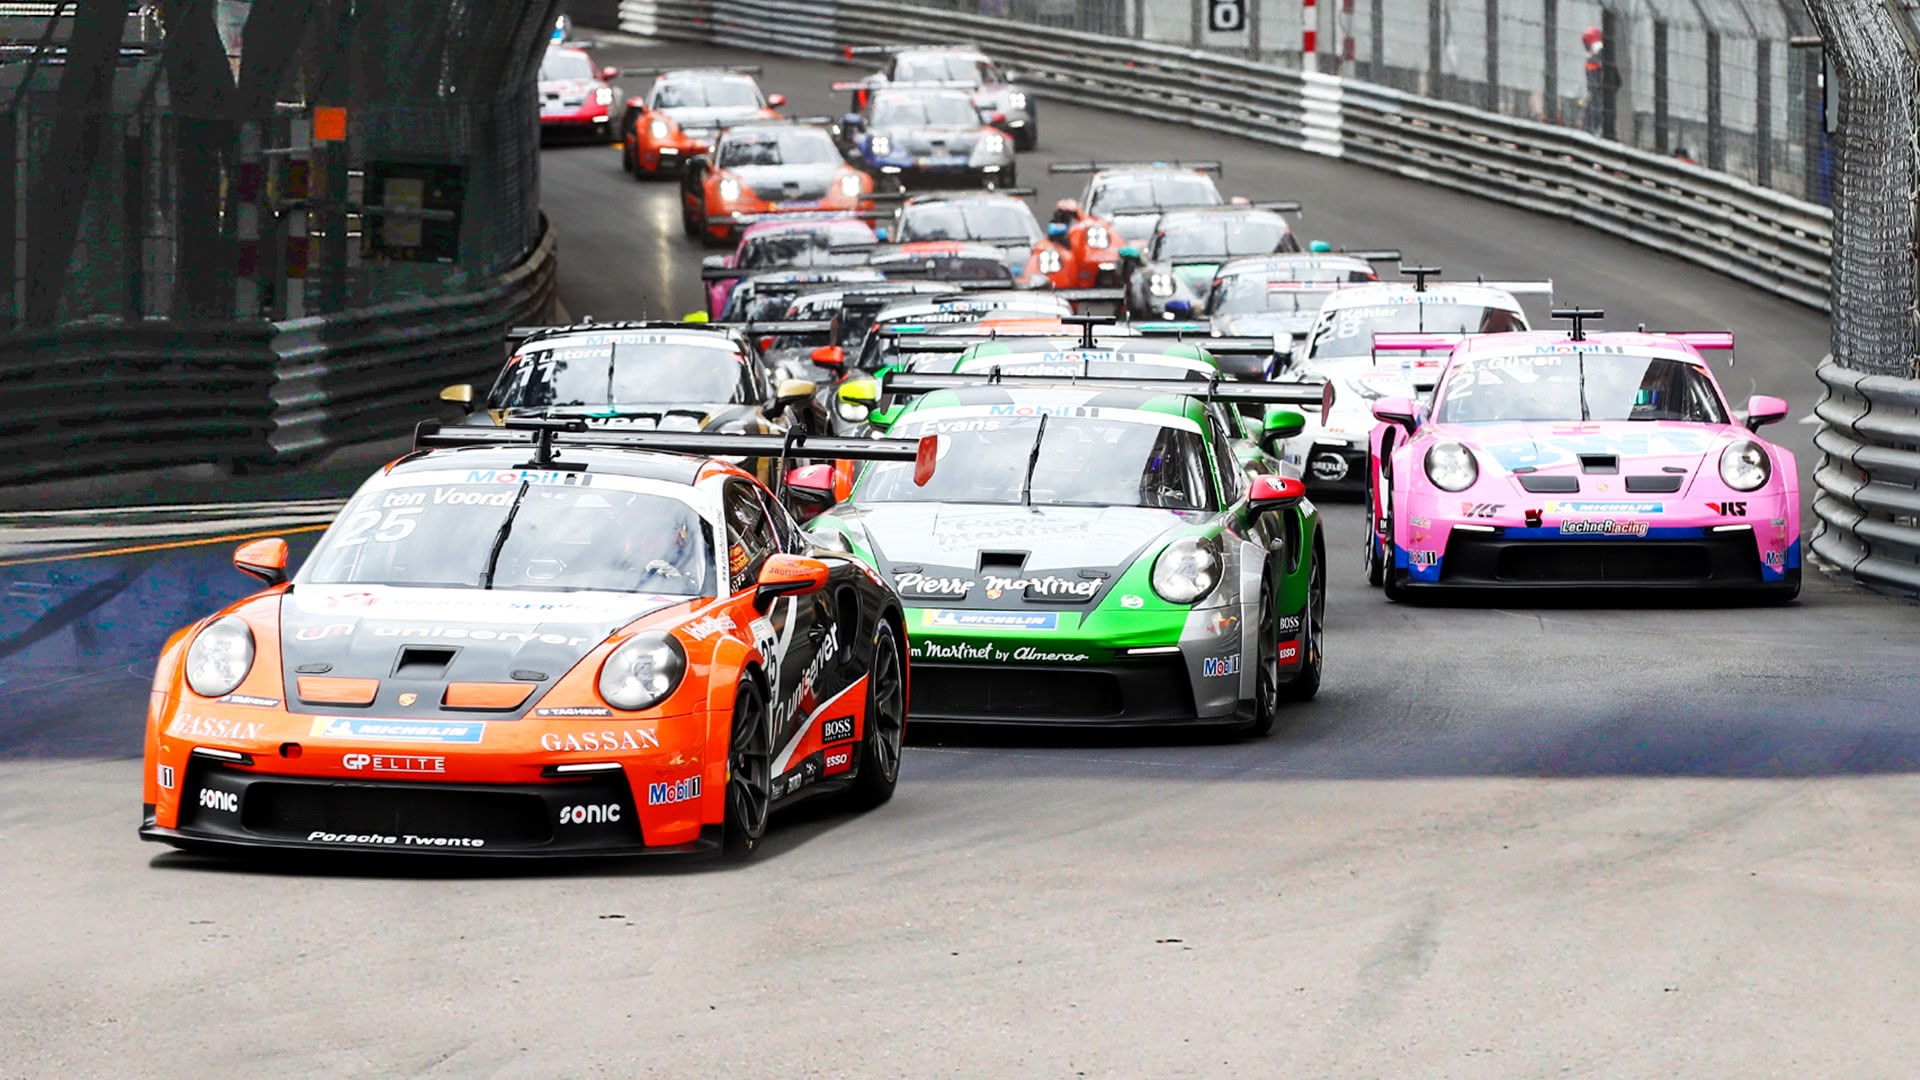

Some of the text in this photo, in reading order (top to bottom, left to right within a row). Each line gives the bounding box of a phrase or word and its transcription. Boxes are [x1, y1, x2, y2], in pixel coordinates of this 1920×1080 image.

[1316, 320, 1361, 346] 28
[1536, 345, 1599, 355] Mobil
[516, 361, 557, 387] 11
[989, 405, 1069, 417] Mobil
[919, 419, 1000, 434] Evans
[464, 470, 559, 485] Mobil
[383, 490, 427, 508] ten
[334, 507, 424, 550] 25
[895, 573, 1104, 597] Pierre Martinet
[960, 615, 1047, 625] MICHELIN
[1279, 616, 1300, 630] BOSS
[373, 625, 588, 647] uniserver
[924, 640, 994, 660] Martinet
[995, 651, 1010, 662] by
[1013, 647, 1089, 661] Almeras
[787, 622, 839, 722] uniserver
[171, 712, 265, 740] GASSAN
[358, 724, 469, 736] MICHELIN
[824, 719, 851, 736] BOSS
[541, 728, 660, 751] GASSAN
[826, 754, 848, 768] ESSO
[649, 778, 691, 805] Mobil
[307, 831, 485, 847] Porsche Twente
